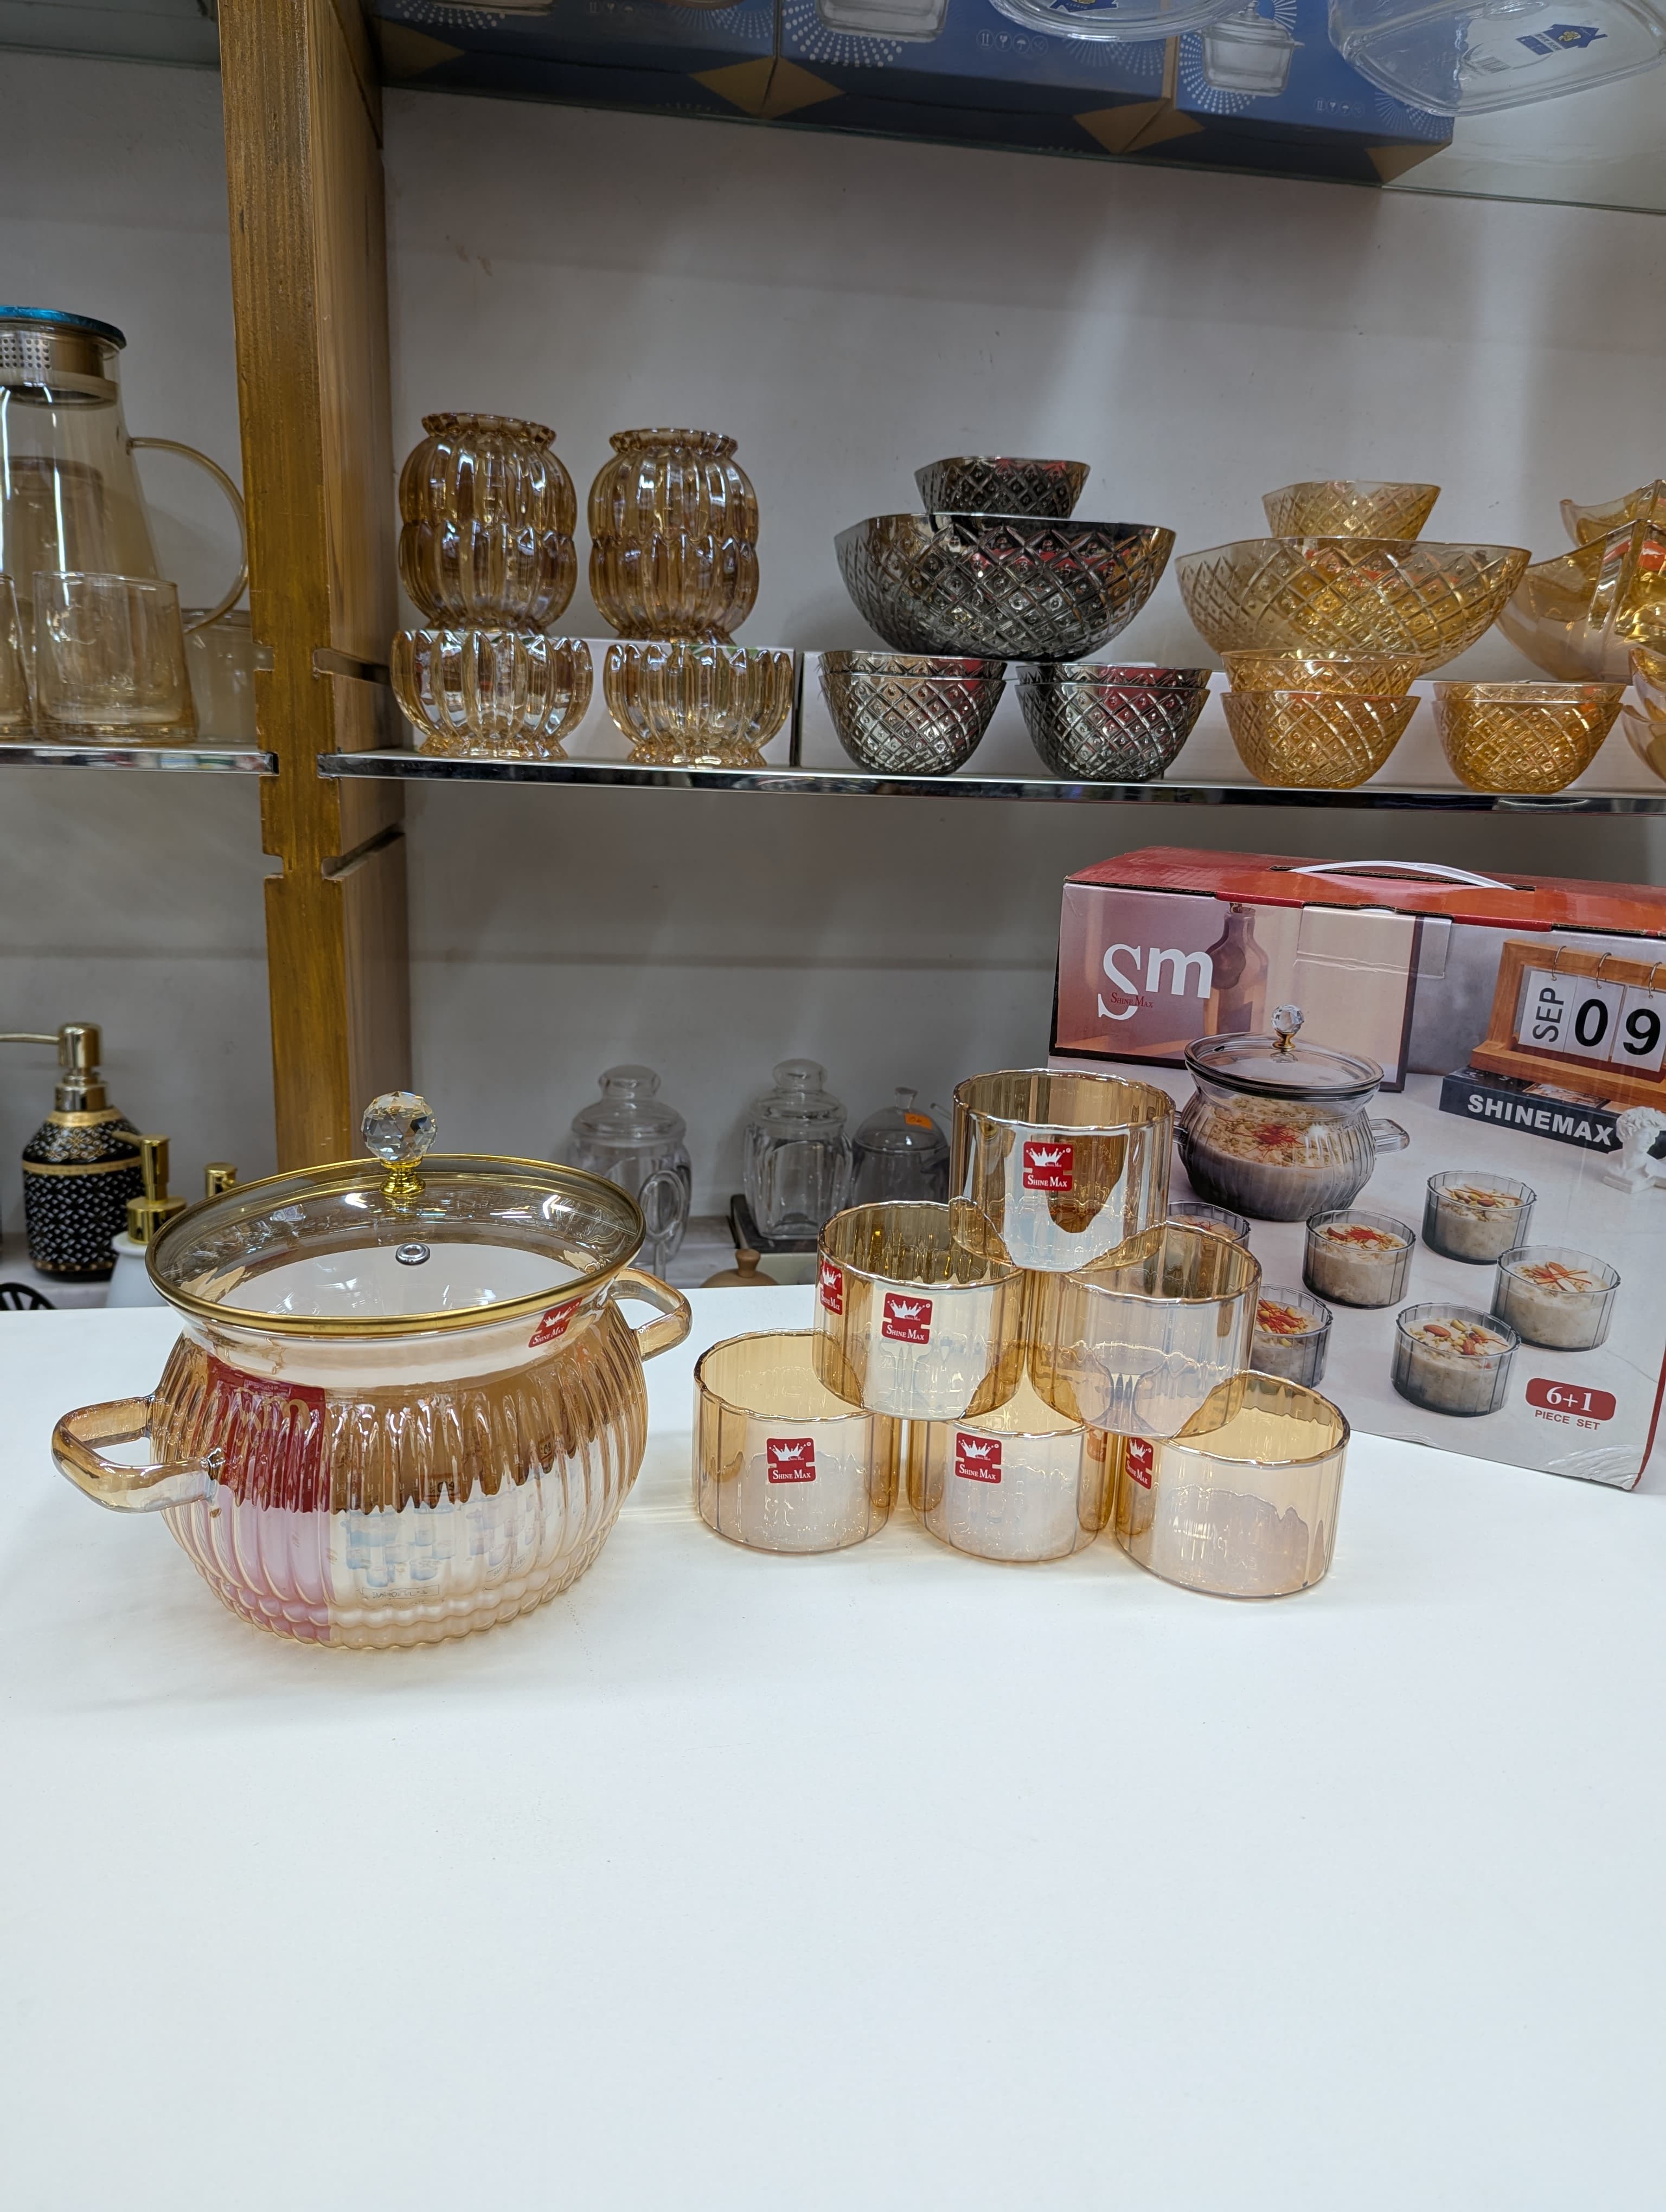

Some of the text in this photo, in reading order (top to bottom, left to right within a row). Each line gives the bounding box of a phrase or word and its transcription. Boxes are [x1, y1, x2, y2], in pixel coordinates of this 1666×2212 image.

[1110, 992, 1154, 1009] SHINE MAX
[1532, 987, 1565, 1043] SEP
[1467, 1094, 1614, 1146] SHINEMAX
[1027, 1174, 1068, 1187] SHINE MAX
[886, 1324, 925, 1341] SHINE MAX
[1546, 1386, 1593, 1412] 6+1
[1534, 1409, 1601, 1431] PIECE SET
[772, 1469, 811, 1480] SHINE MAX
[959, 1463, 996, 1480] SHINE MAX
